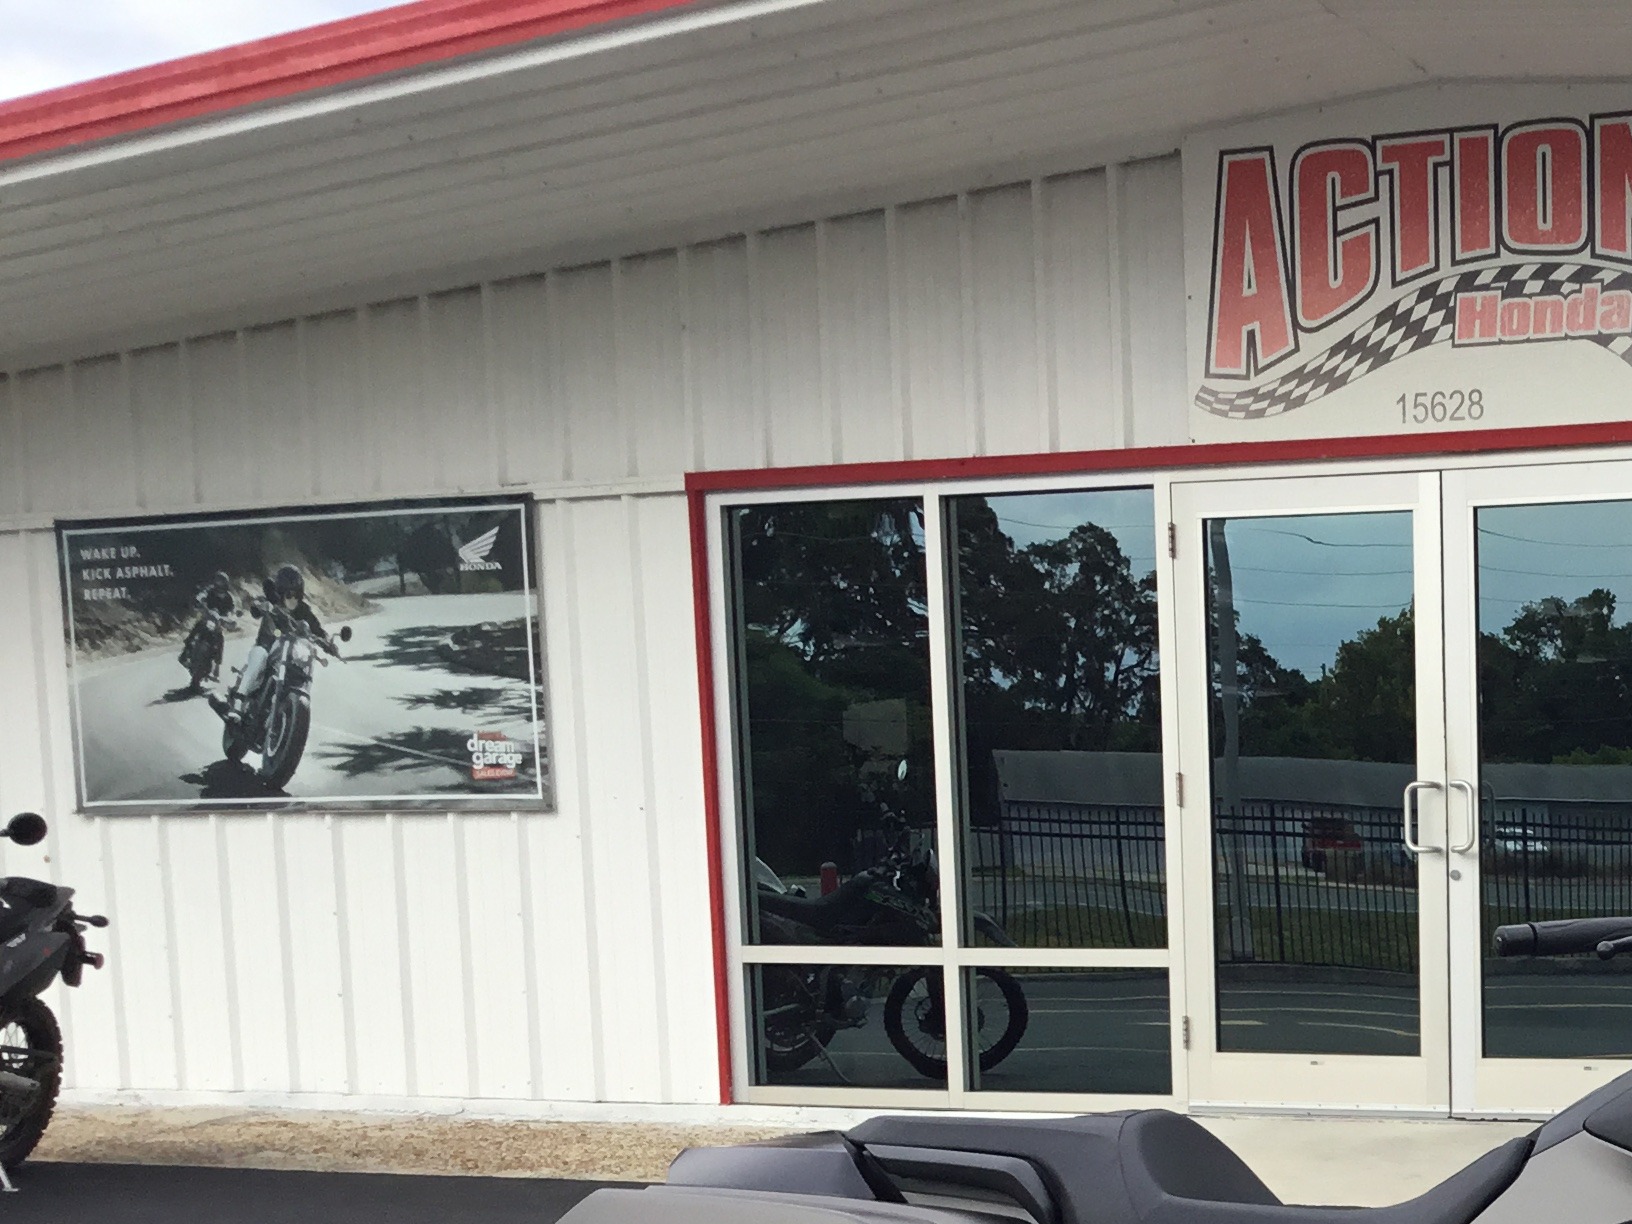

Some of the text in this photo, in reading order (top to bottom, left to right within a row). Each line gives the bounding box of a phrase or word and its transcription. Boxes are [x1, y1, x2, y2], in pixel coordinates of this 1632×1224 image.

[1396, 389, 1485, 424] 15628
[81, 546, 141, 560] WAKE UP.
[82, 567, 112, 580] KICK
[459, 561, 503, 571] HONDA
[467, 733, 514, 752] dream
[472, 752, 522, 770] garage
